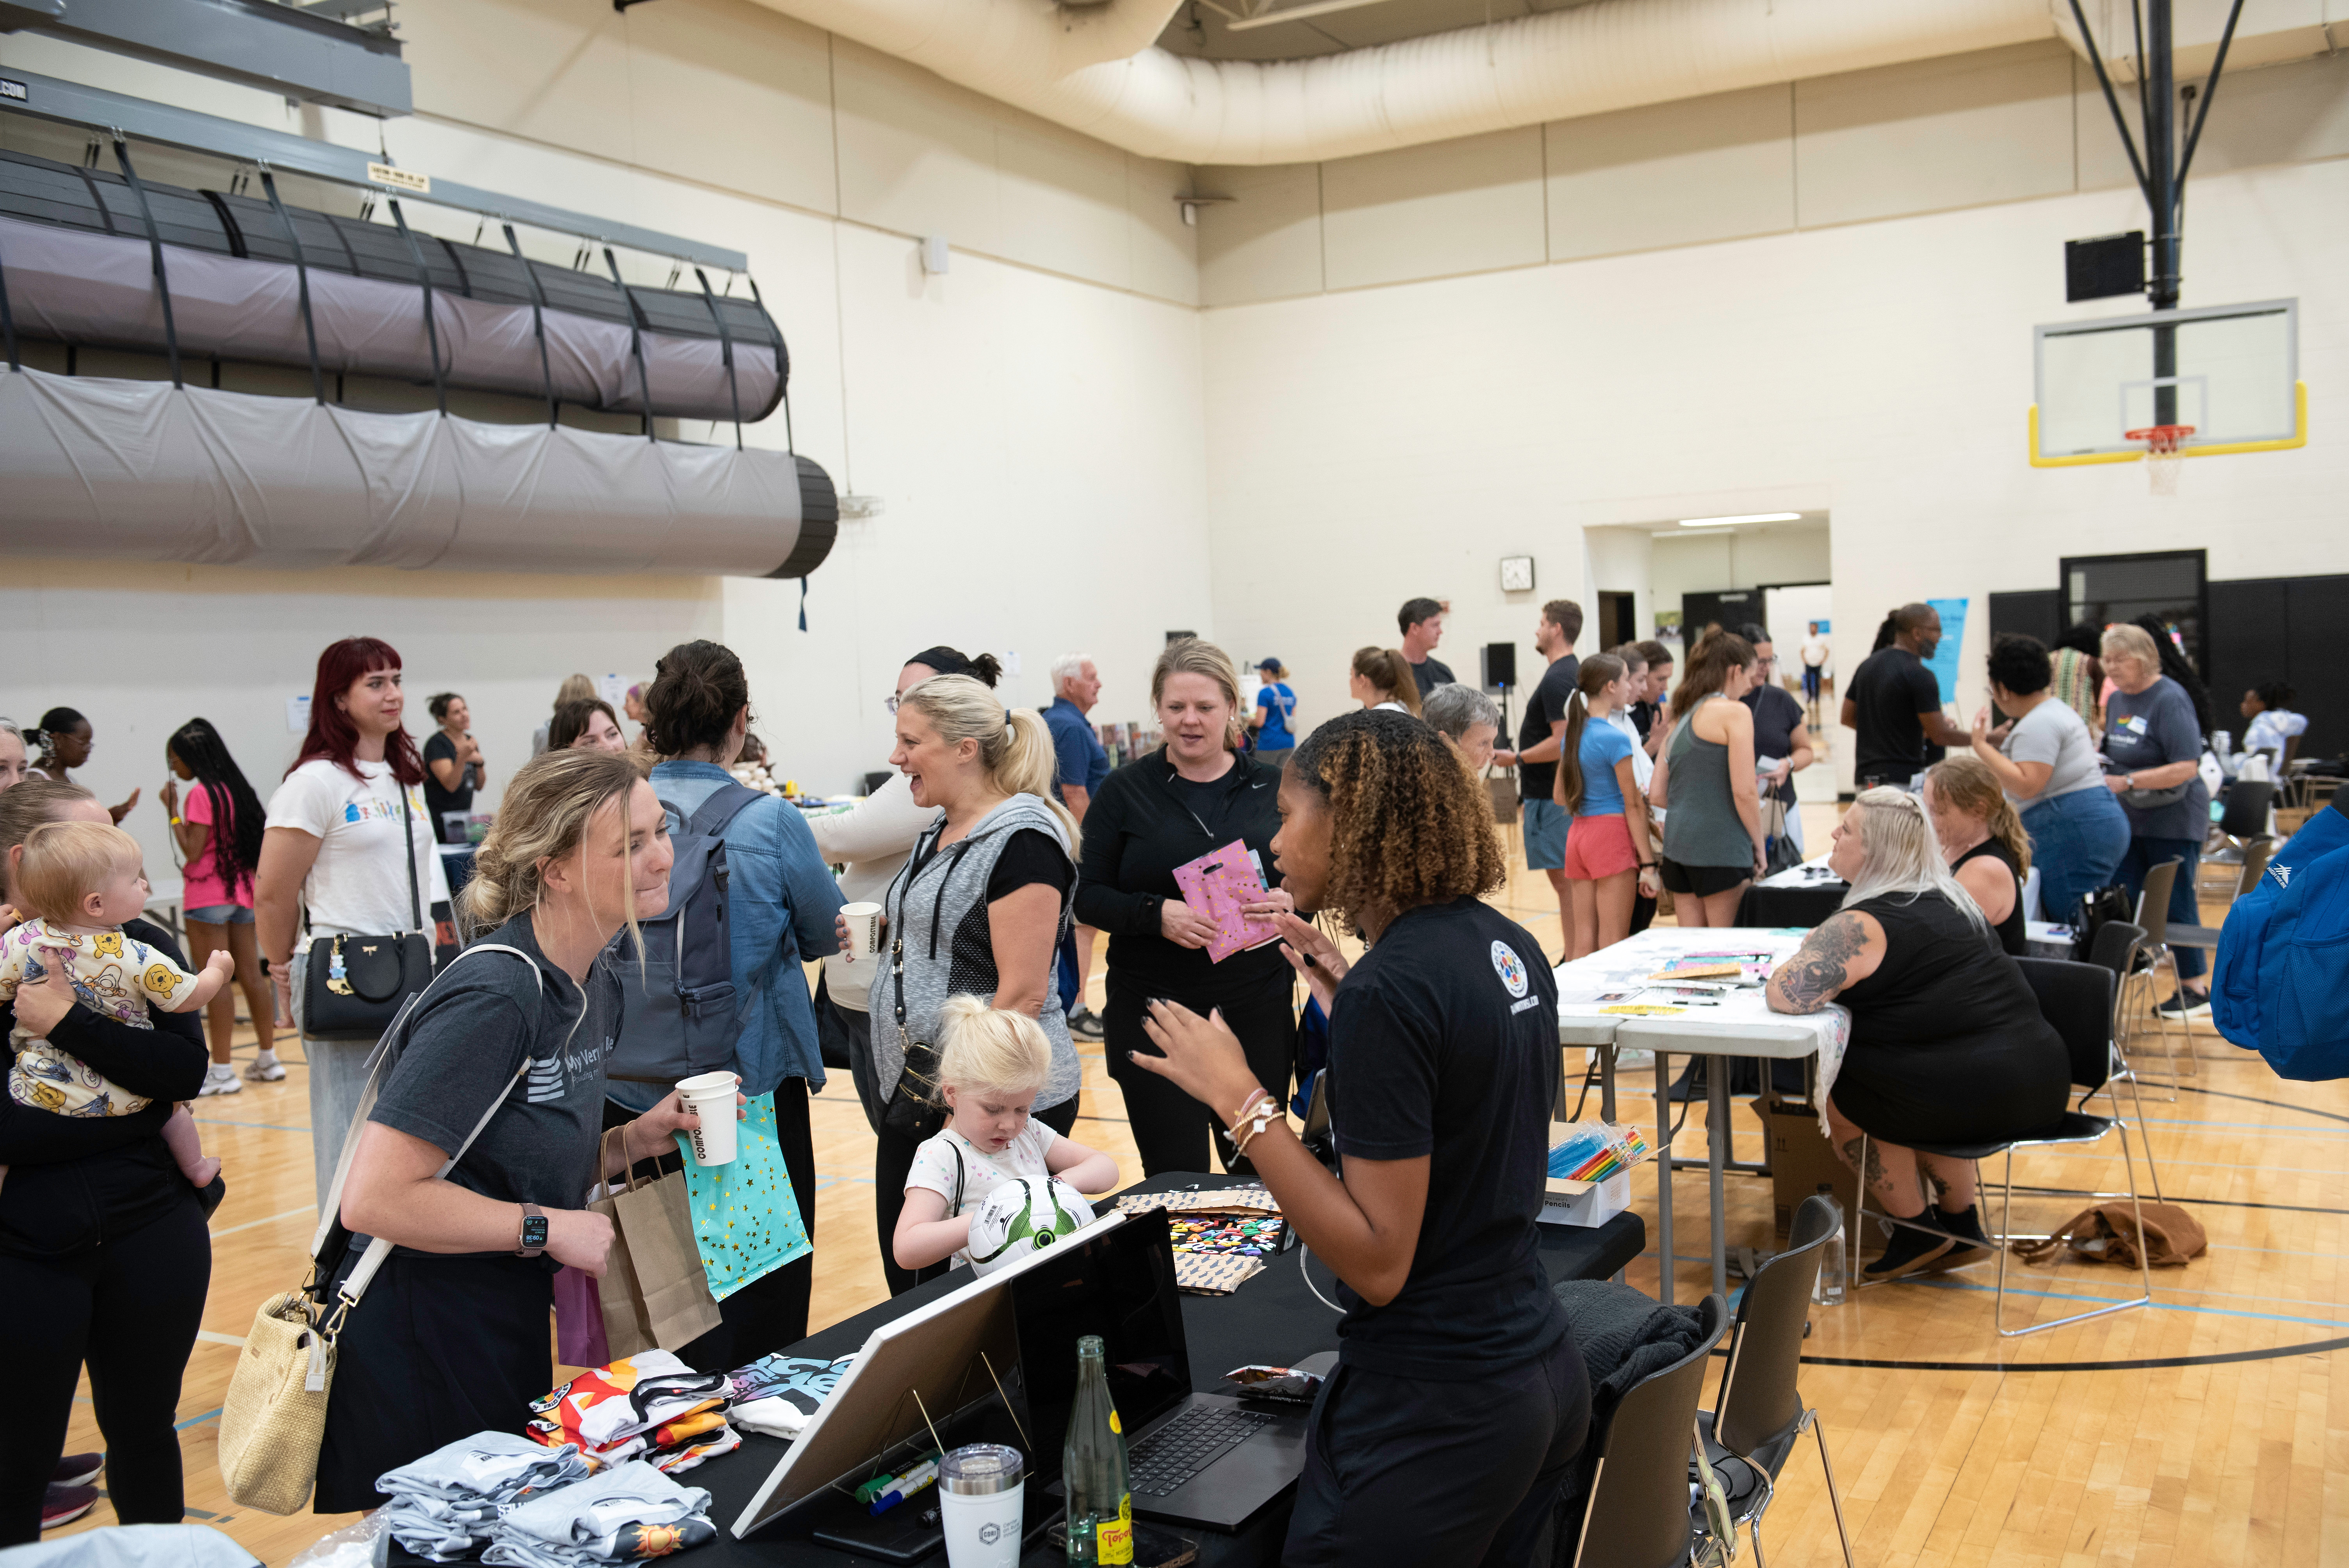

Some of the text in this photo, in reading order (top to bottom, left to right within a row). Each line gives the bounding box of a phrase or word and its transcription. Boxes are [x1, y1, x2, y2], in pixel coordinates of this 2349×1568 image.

[2267, 866, 2287, 889] HIGH SIERR
[565, 1055, 581, 1073] My
[605, 1036, 614, 1051] Be
[688, 1105, 706, 1159] COMPOBLE
[1545, 1200, 1570, 1208] Pencils
[544, 1399, 558, 1409] CITIES
[1101, 1527, 1128, 1548] Topo
